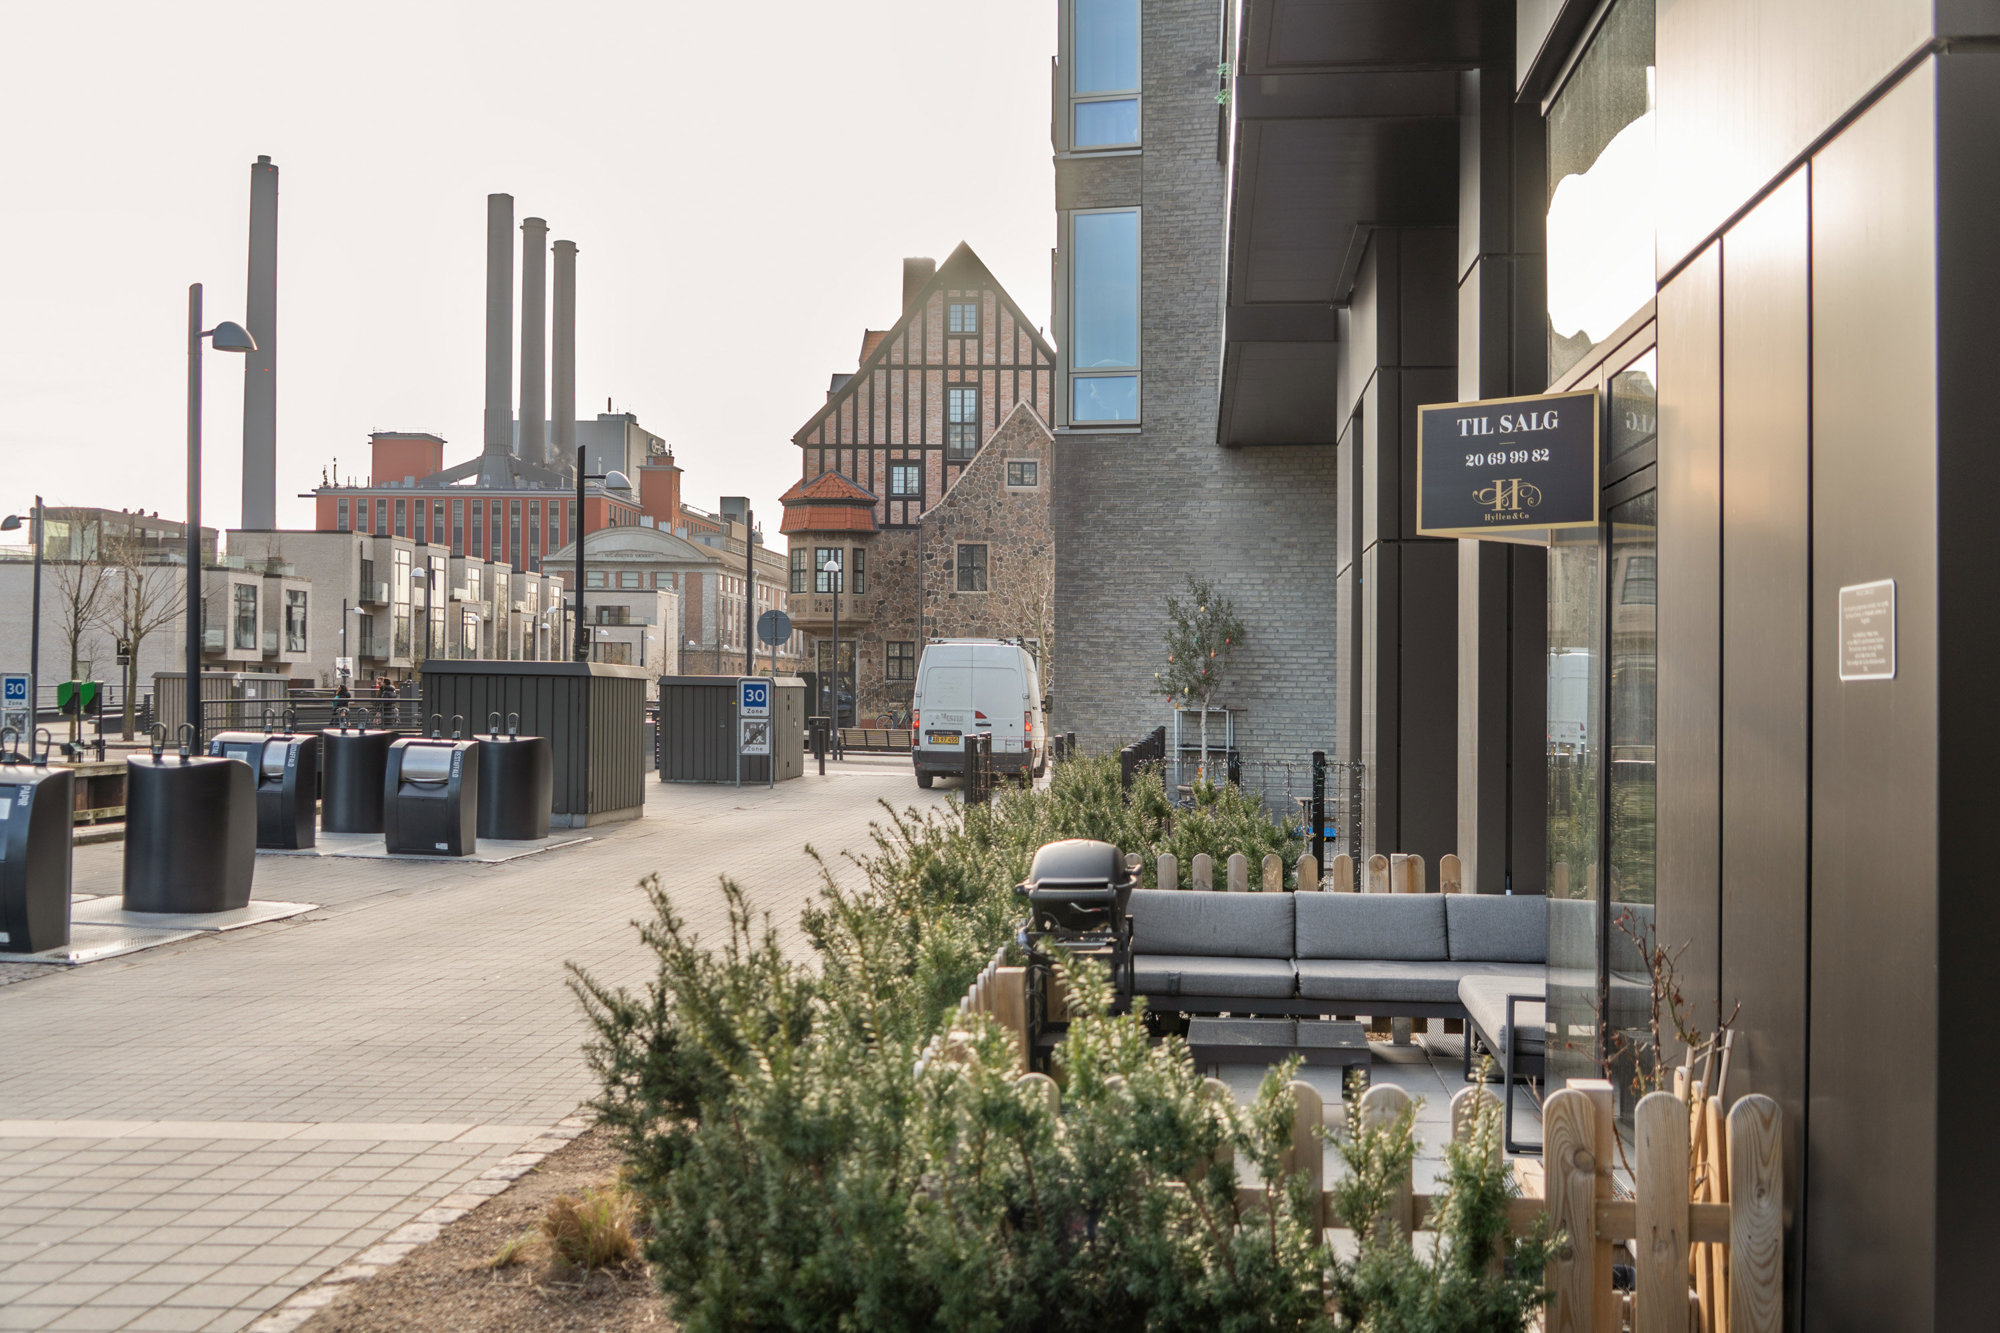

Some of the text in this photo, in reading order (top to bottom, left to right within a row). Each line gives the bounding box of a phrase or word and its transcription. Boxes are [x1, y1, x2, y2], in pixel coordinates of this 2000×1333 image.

[1457, 410, 1559, 437] TIL SALG
[1465, 448, 1550, 467] 20 69 99 82
[7, 683, 24, 695] 30
[745, 689, 765, 702] 30
[17, 785, 32, 806] PAPIR
